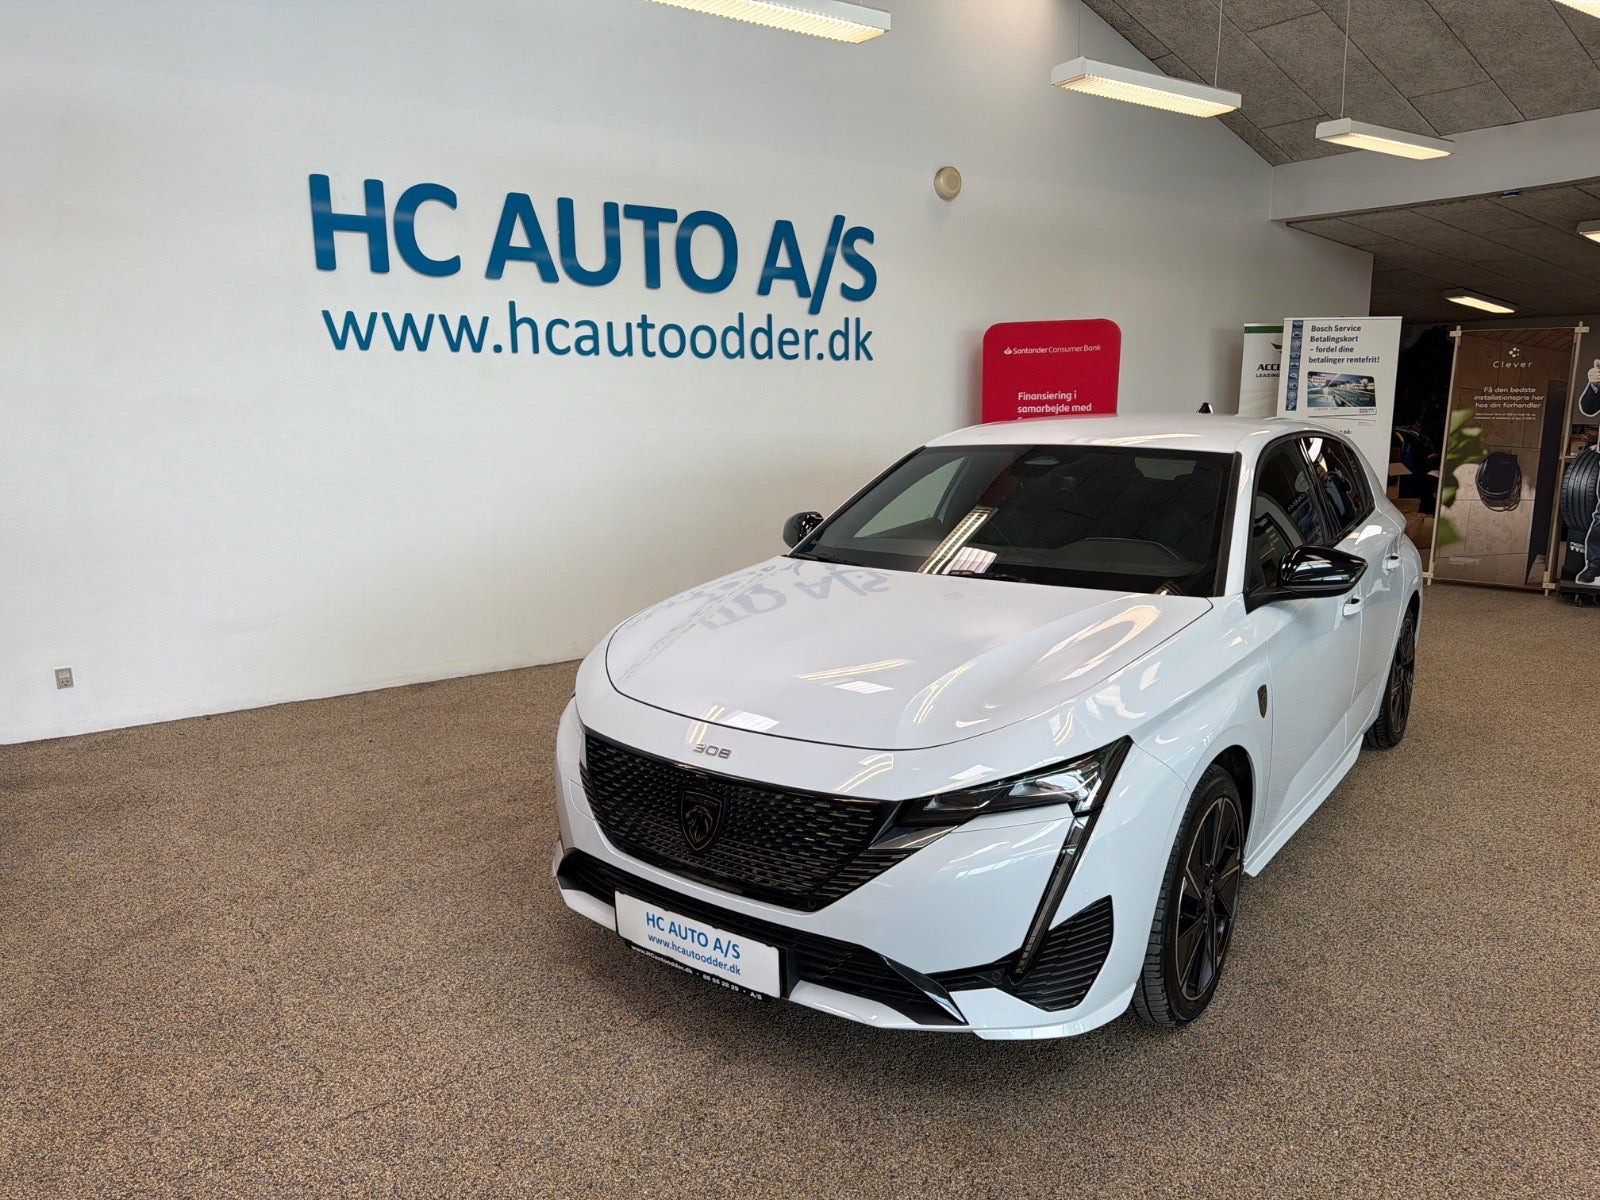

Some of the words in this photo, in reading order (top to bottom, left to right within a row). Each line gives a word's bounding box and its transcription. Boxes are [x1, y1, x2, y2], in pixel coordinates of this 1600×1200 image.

[308, 173, 461, 277] HC
[485, 191, 738, 293] AUTO
[757, 214, 877, 315] A/S
[322, 301, 874, 361] www.hcautoodder.dk
[1310, 335, 1359, 343] Betalingskort
[1084, 344, 1101, 352] Bank
[1309, 356, 1345, 364] betalinger
[1492, 361, 1533, 369] Clever
[1018, 391, 1072, 402] Finansiering
[1017, 404, 1070, 414] samarbejde
[1071, 403, 1092, 412] med
[693, 743, 732, 759] 308
[646, 912, 665, 931] HC
[668, 921, 709, 948] AUTO
[712, 937, 741, 960] A/S
[648, 933, 741, 976] www.hcautoodder.dk
